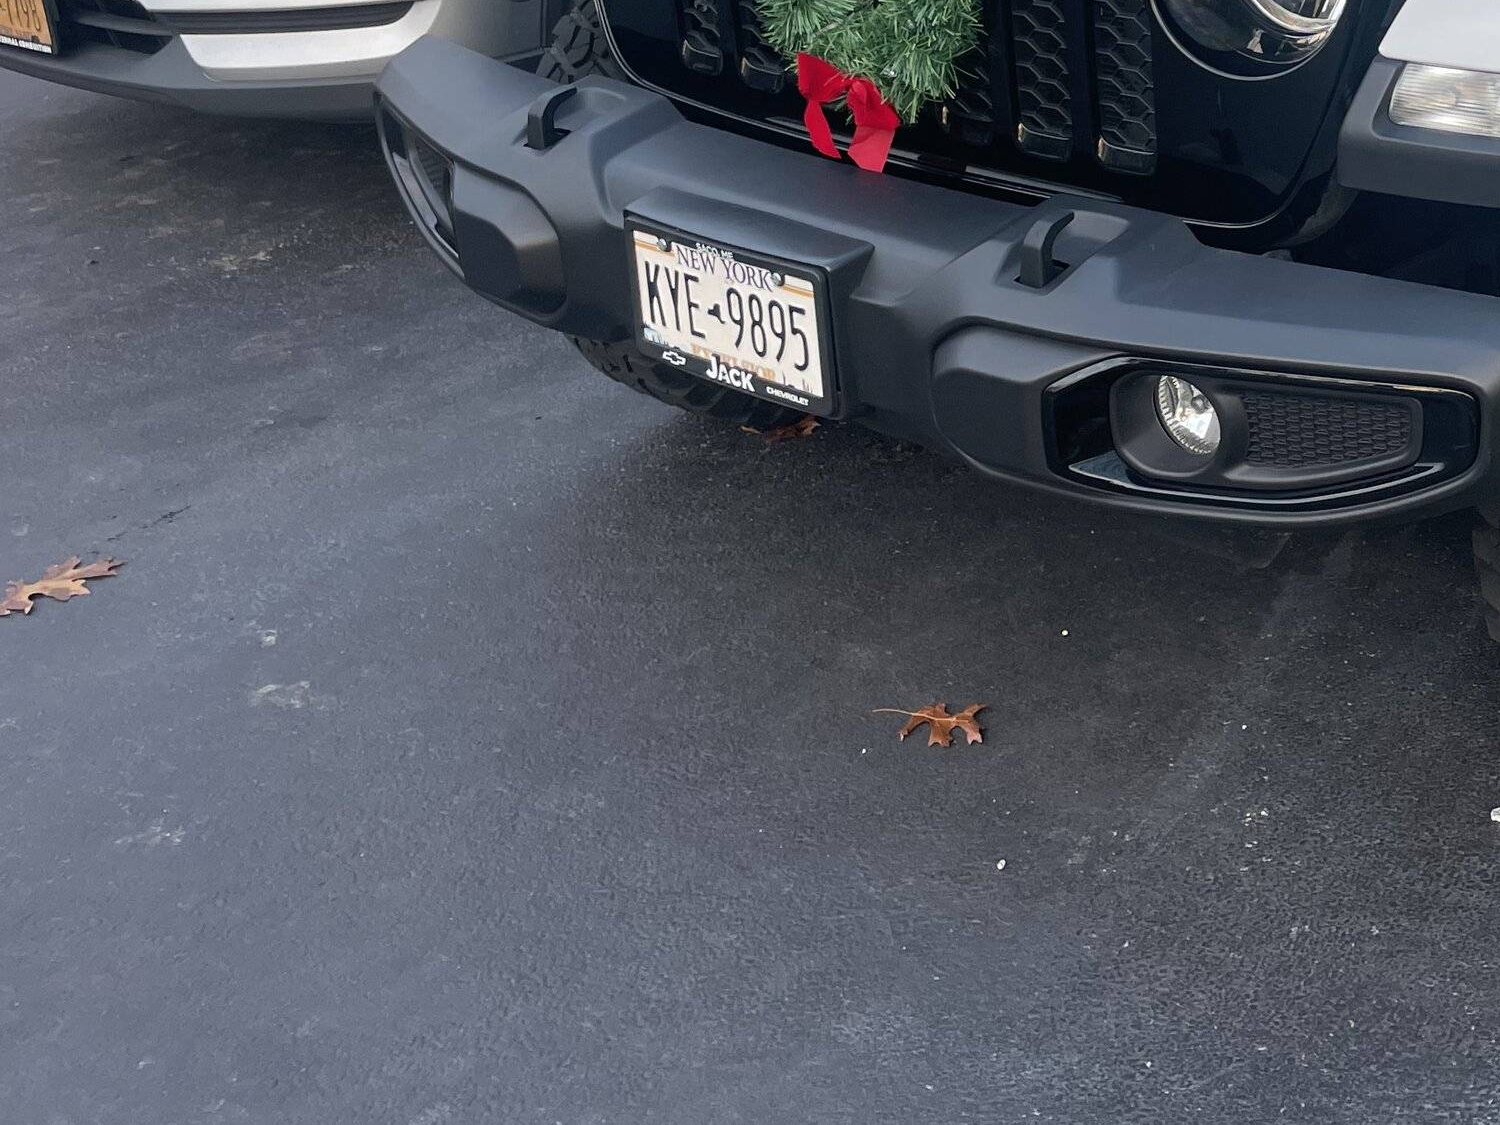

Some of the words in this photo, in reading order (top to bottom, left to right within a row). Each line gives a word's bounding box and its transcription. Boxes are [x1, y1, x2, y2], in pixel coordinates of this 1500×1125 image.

[676, 245, 716, 275] NEW
[721, 258, 774, 293] YORK
[645, 261, 706, 339] KYE
[726, 287, 810, 371] 9895
[706, 355, 755, 392] JACK
[766, 386, 809, 406] CHEVROLET
